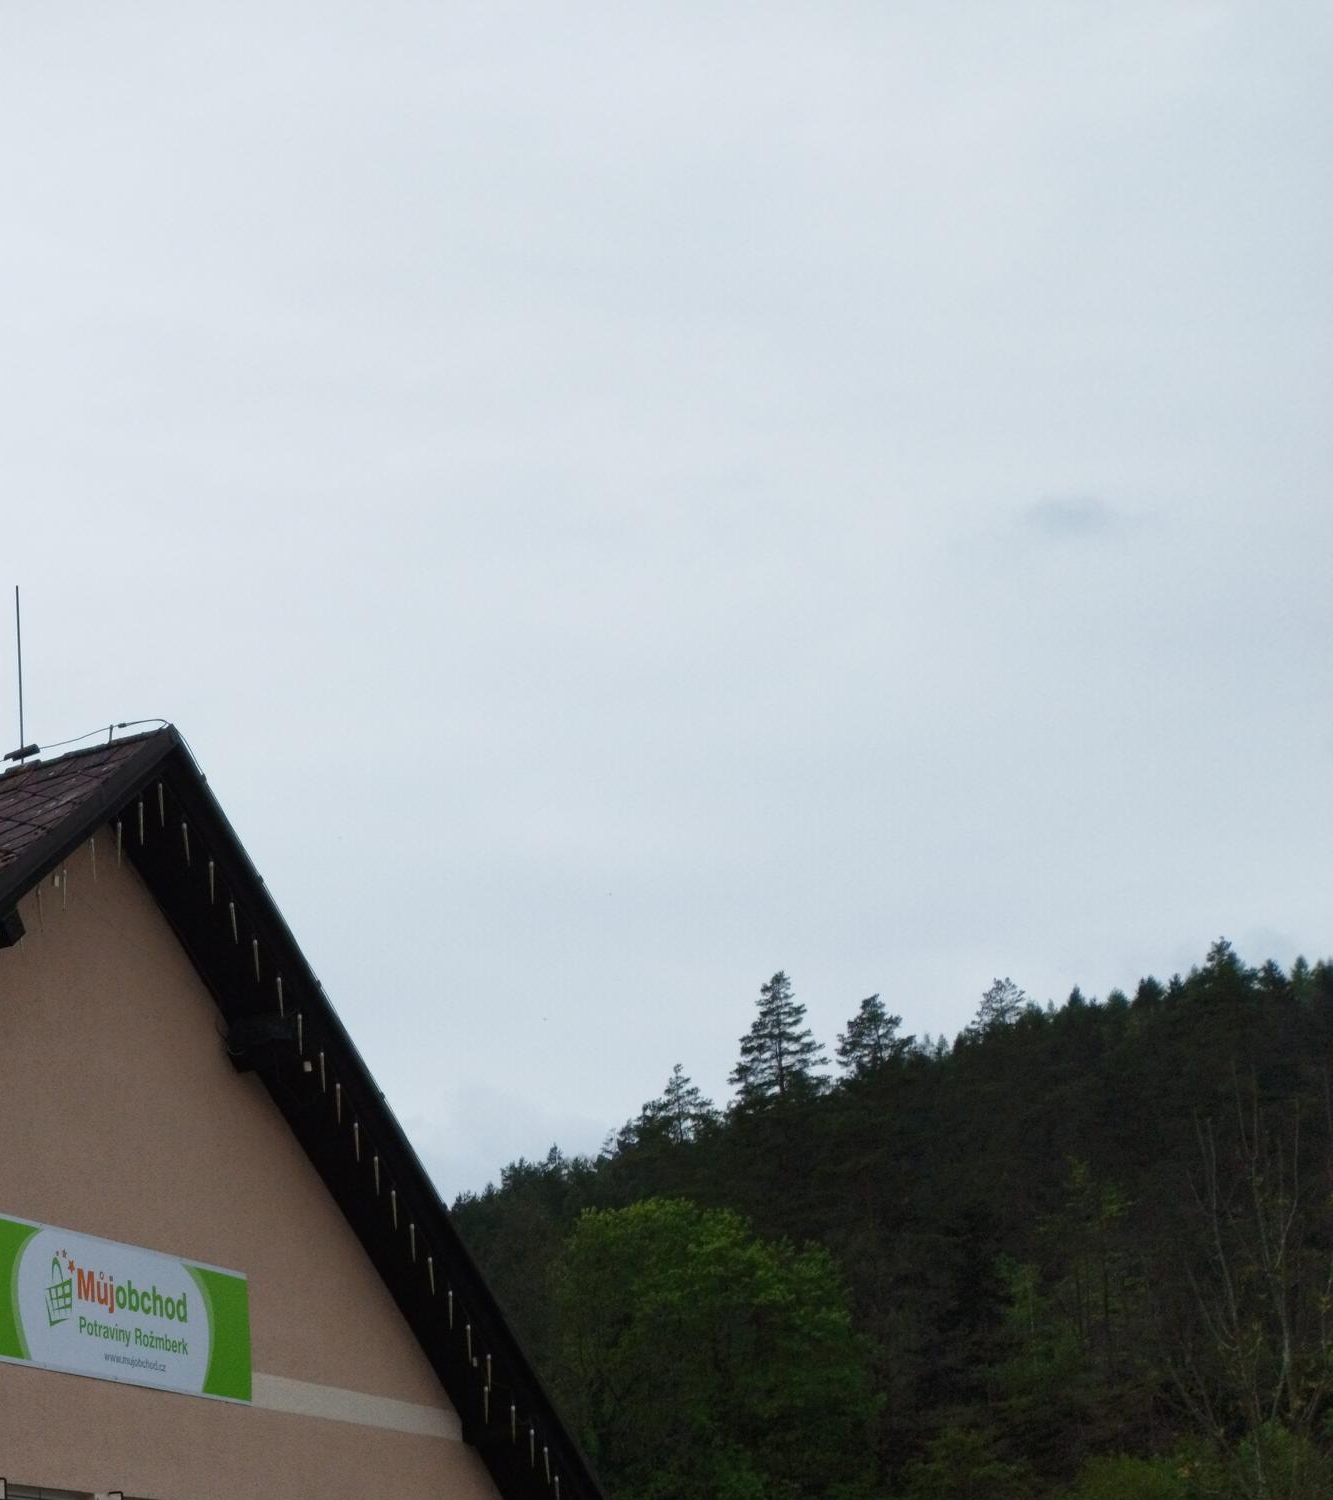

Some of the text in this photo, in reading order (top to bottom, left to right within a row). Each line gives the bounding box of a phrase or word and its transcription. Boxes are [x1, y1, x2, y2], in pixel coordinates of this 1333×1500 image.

[77, 1267, 188, 1323] Můjobchod
[79, 1316, 189, 1355] Potraviny Rožmberk
[104, 1352, 166, 1372] www.mujobchod.cz
